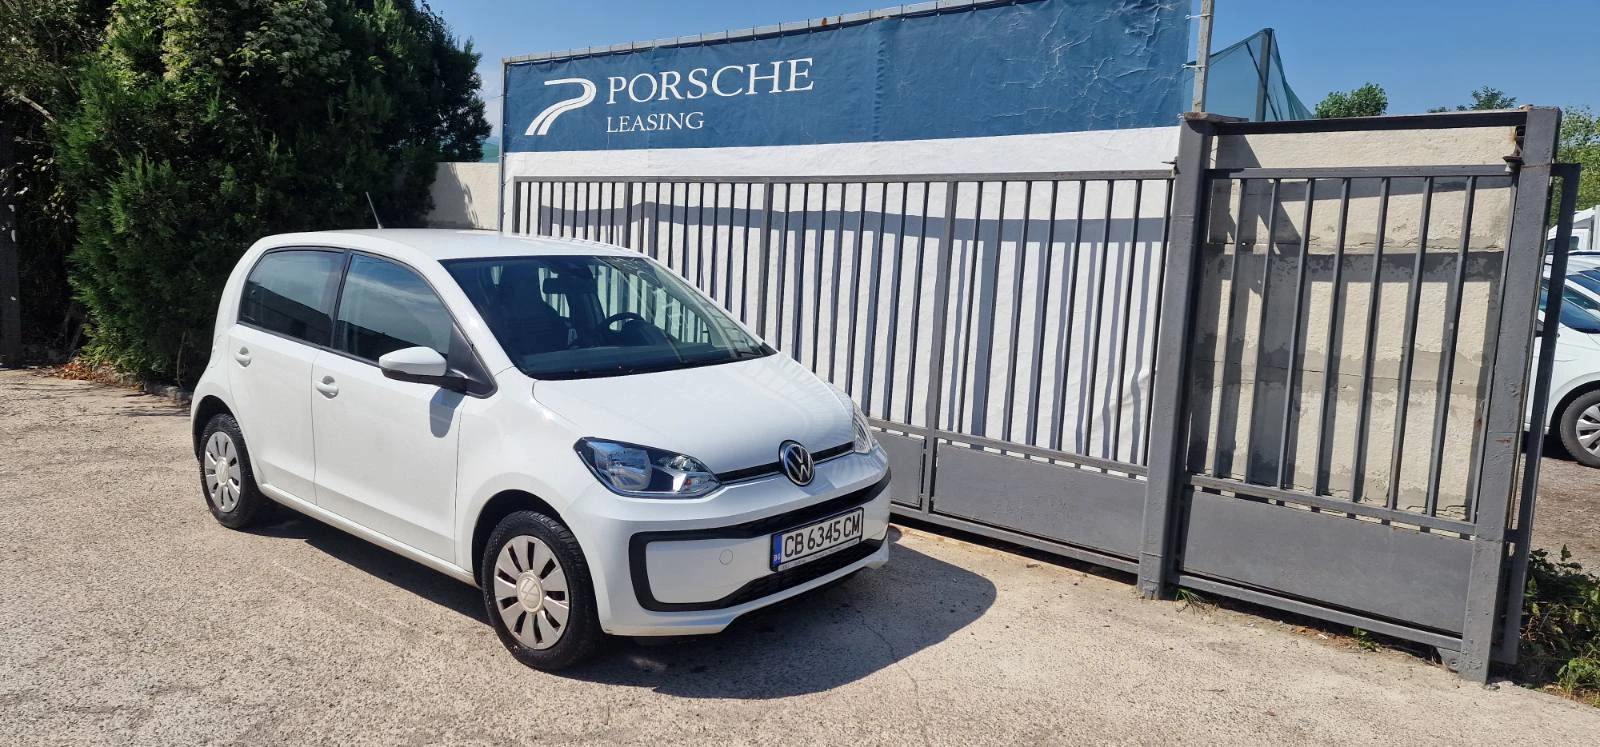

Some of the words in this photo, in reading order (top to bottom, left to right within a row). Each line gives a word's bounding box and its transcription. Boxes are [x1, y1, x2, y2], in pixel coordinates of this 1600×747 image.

[606, 57, 814, 105] PORSCHE
[606, 111, 704, 133] LEASING
[784, 443, 814, 485] VW
[784, 533, 804, 558] CB
[807, 521, 841, 551] 6345
[843, 513, 861, 538] CM
